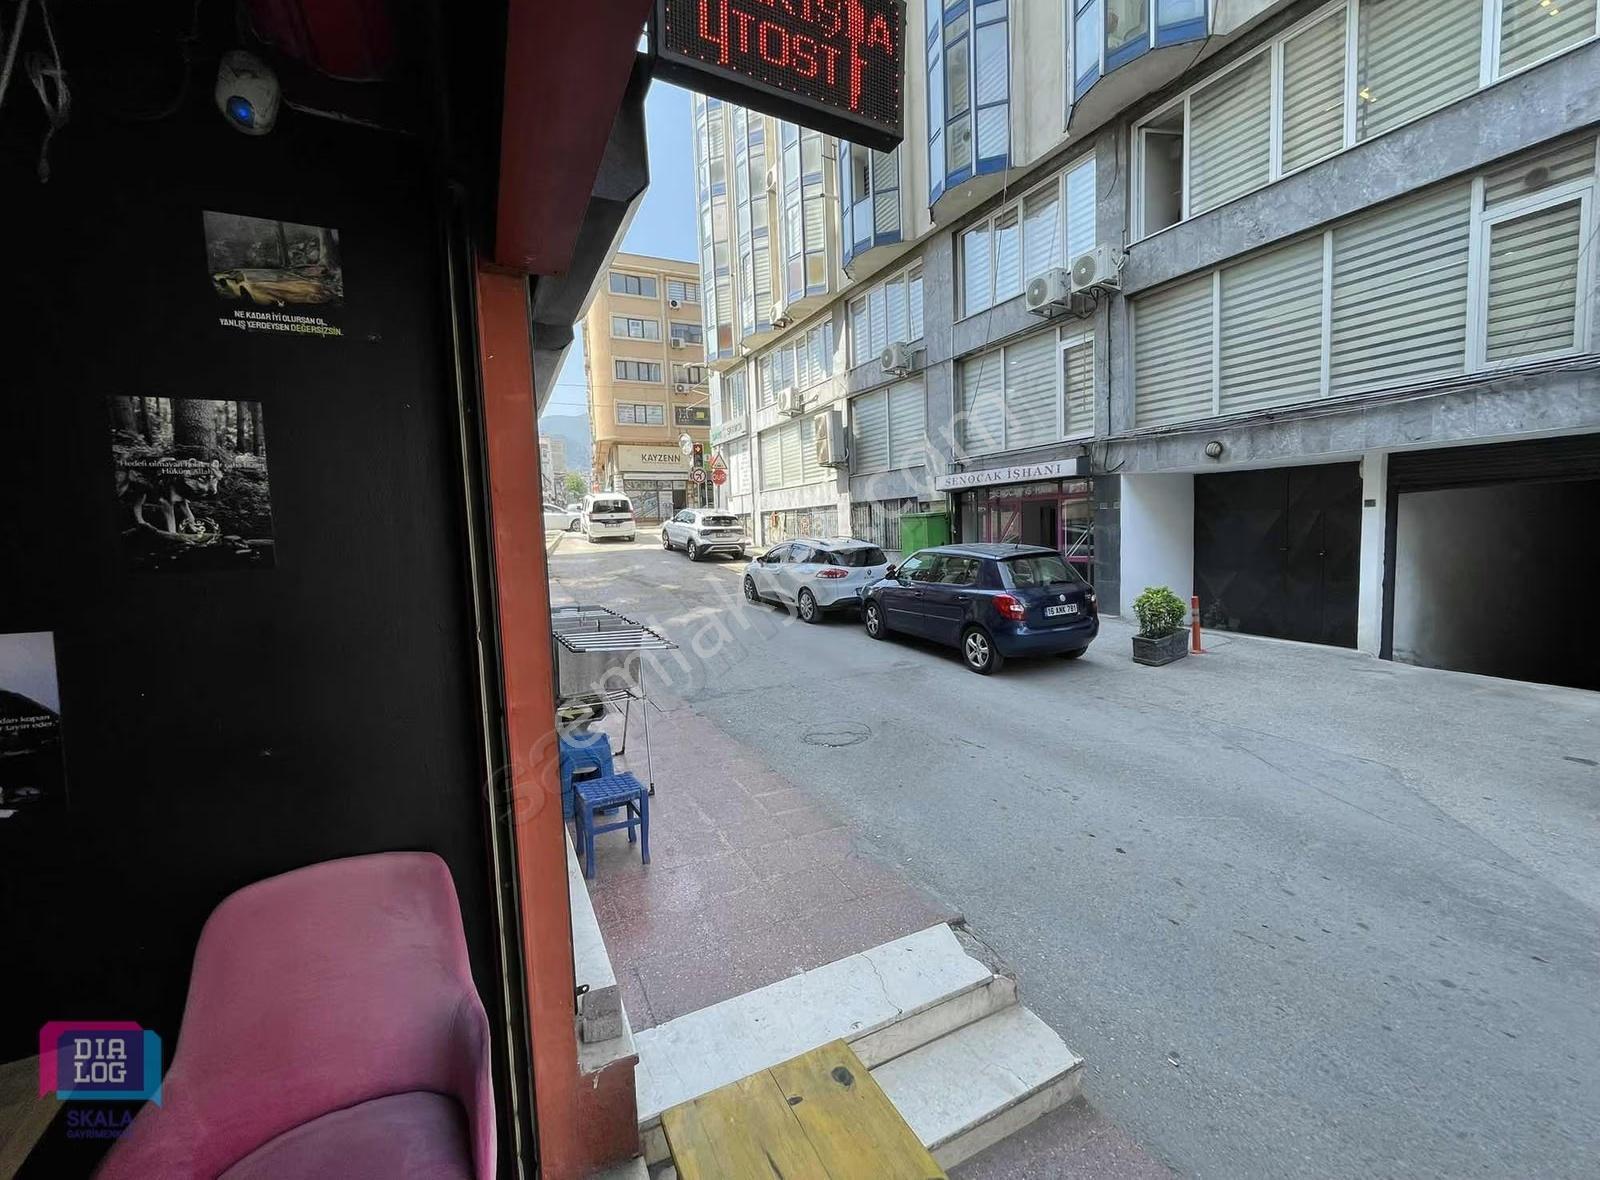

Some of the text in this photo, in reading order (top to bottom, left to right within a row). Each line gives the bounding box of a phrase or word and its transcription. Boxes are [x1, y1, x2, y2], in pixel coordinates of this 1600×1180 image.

[731, 8, 841, 86] TOST
[219, 318, 247, 331] YANLIŞ
[247, 320, 290, 331] YERDEYSEN
[234, 310, 245, 319] NE
[246, 311, 272, 321] KADAR
[282, 314, 316, 325] OLURSAN
[641, 453, 681, 463] KAYZENN
